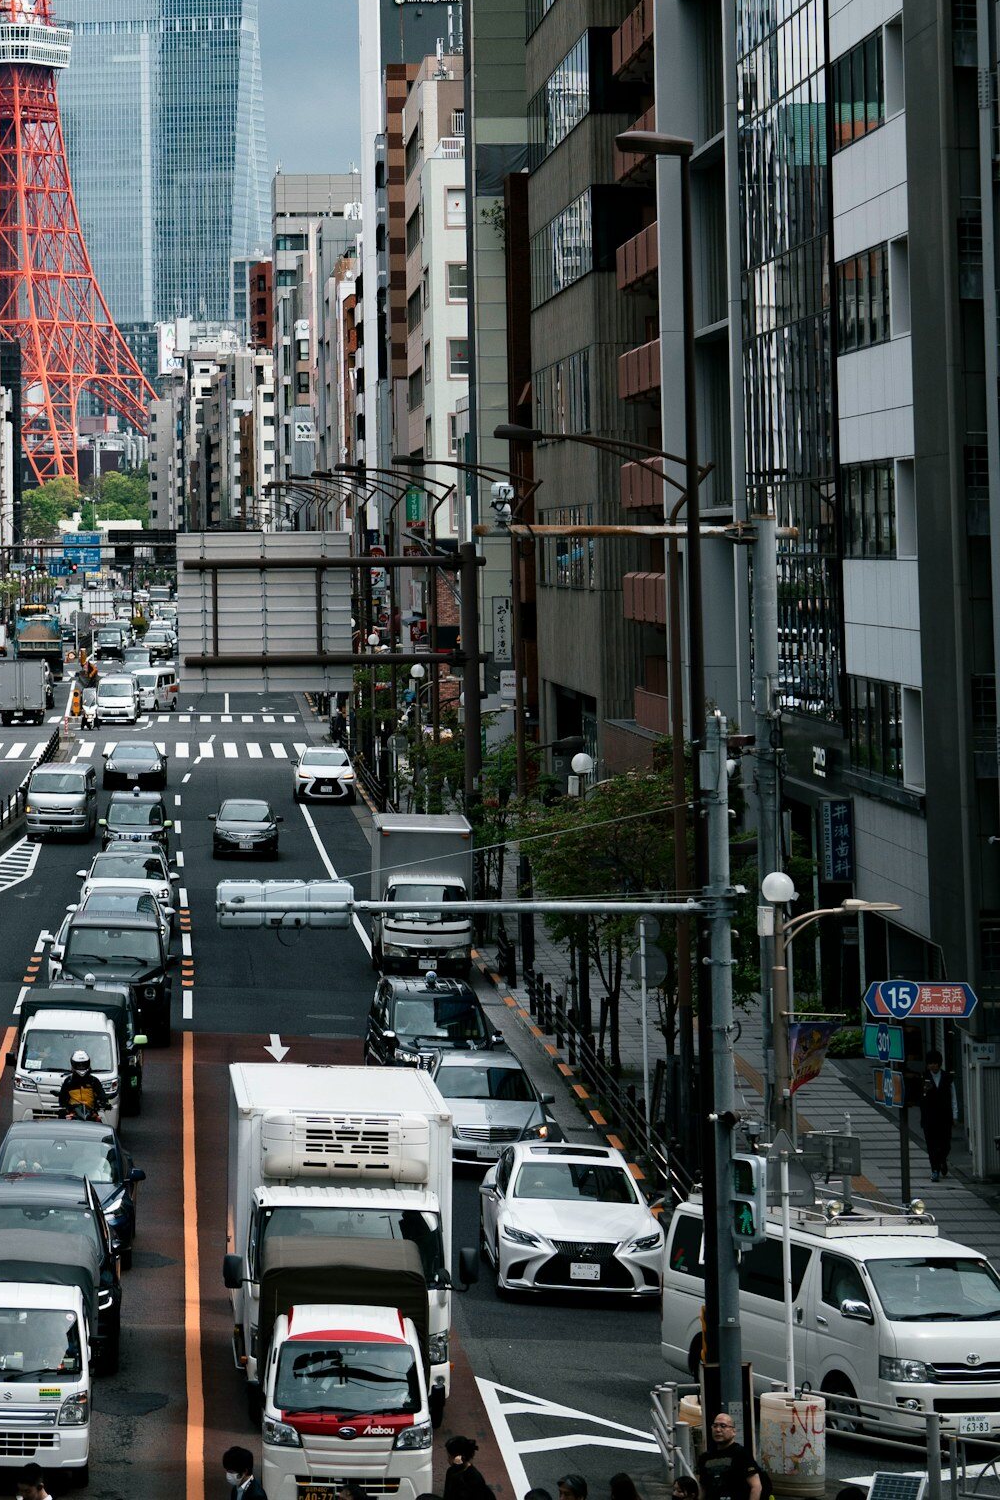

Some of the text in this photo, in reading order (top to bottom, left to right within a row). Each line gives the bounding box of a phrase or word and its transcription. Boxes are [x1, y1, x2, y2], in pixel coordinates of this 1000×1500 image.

[554, 759, 563, 771] P
[887, 987, 912, 1009] 15
[921, 988, 962, 1003] 第一京浜
[920, 1004, 950, 1013] Daiichikeihin
[878, 1033, 890, 1052] 301
[966, 1422, 989, 1432] 63-83
